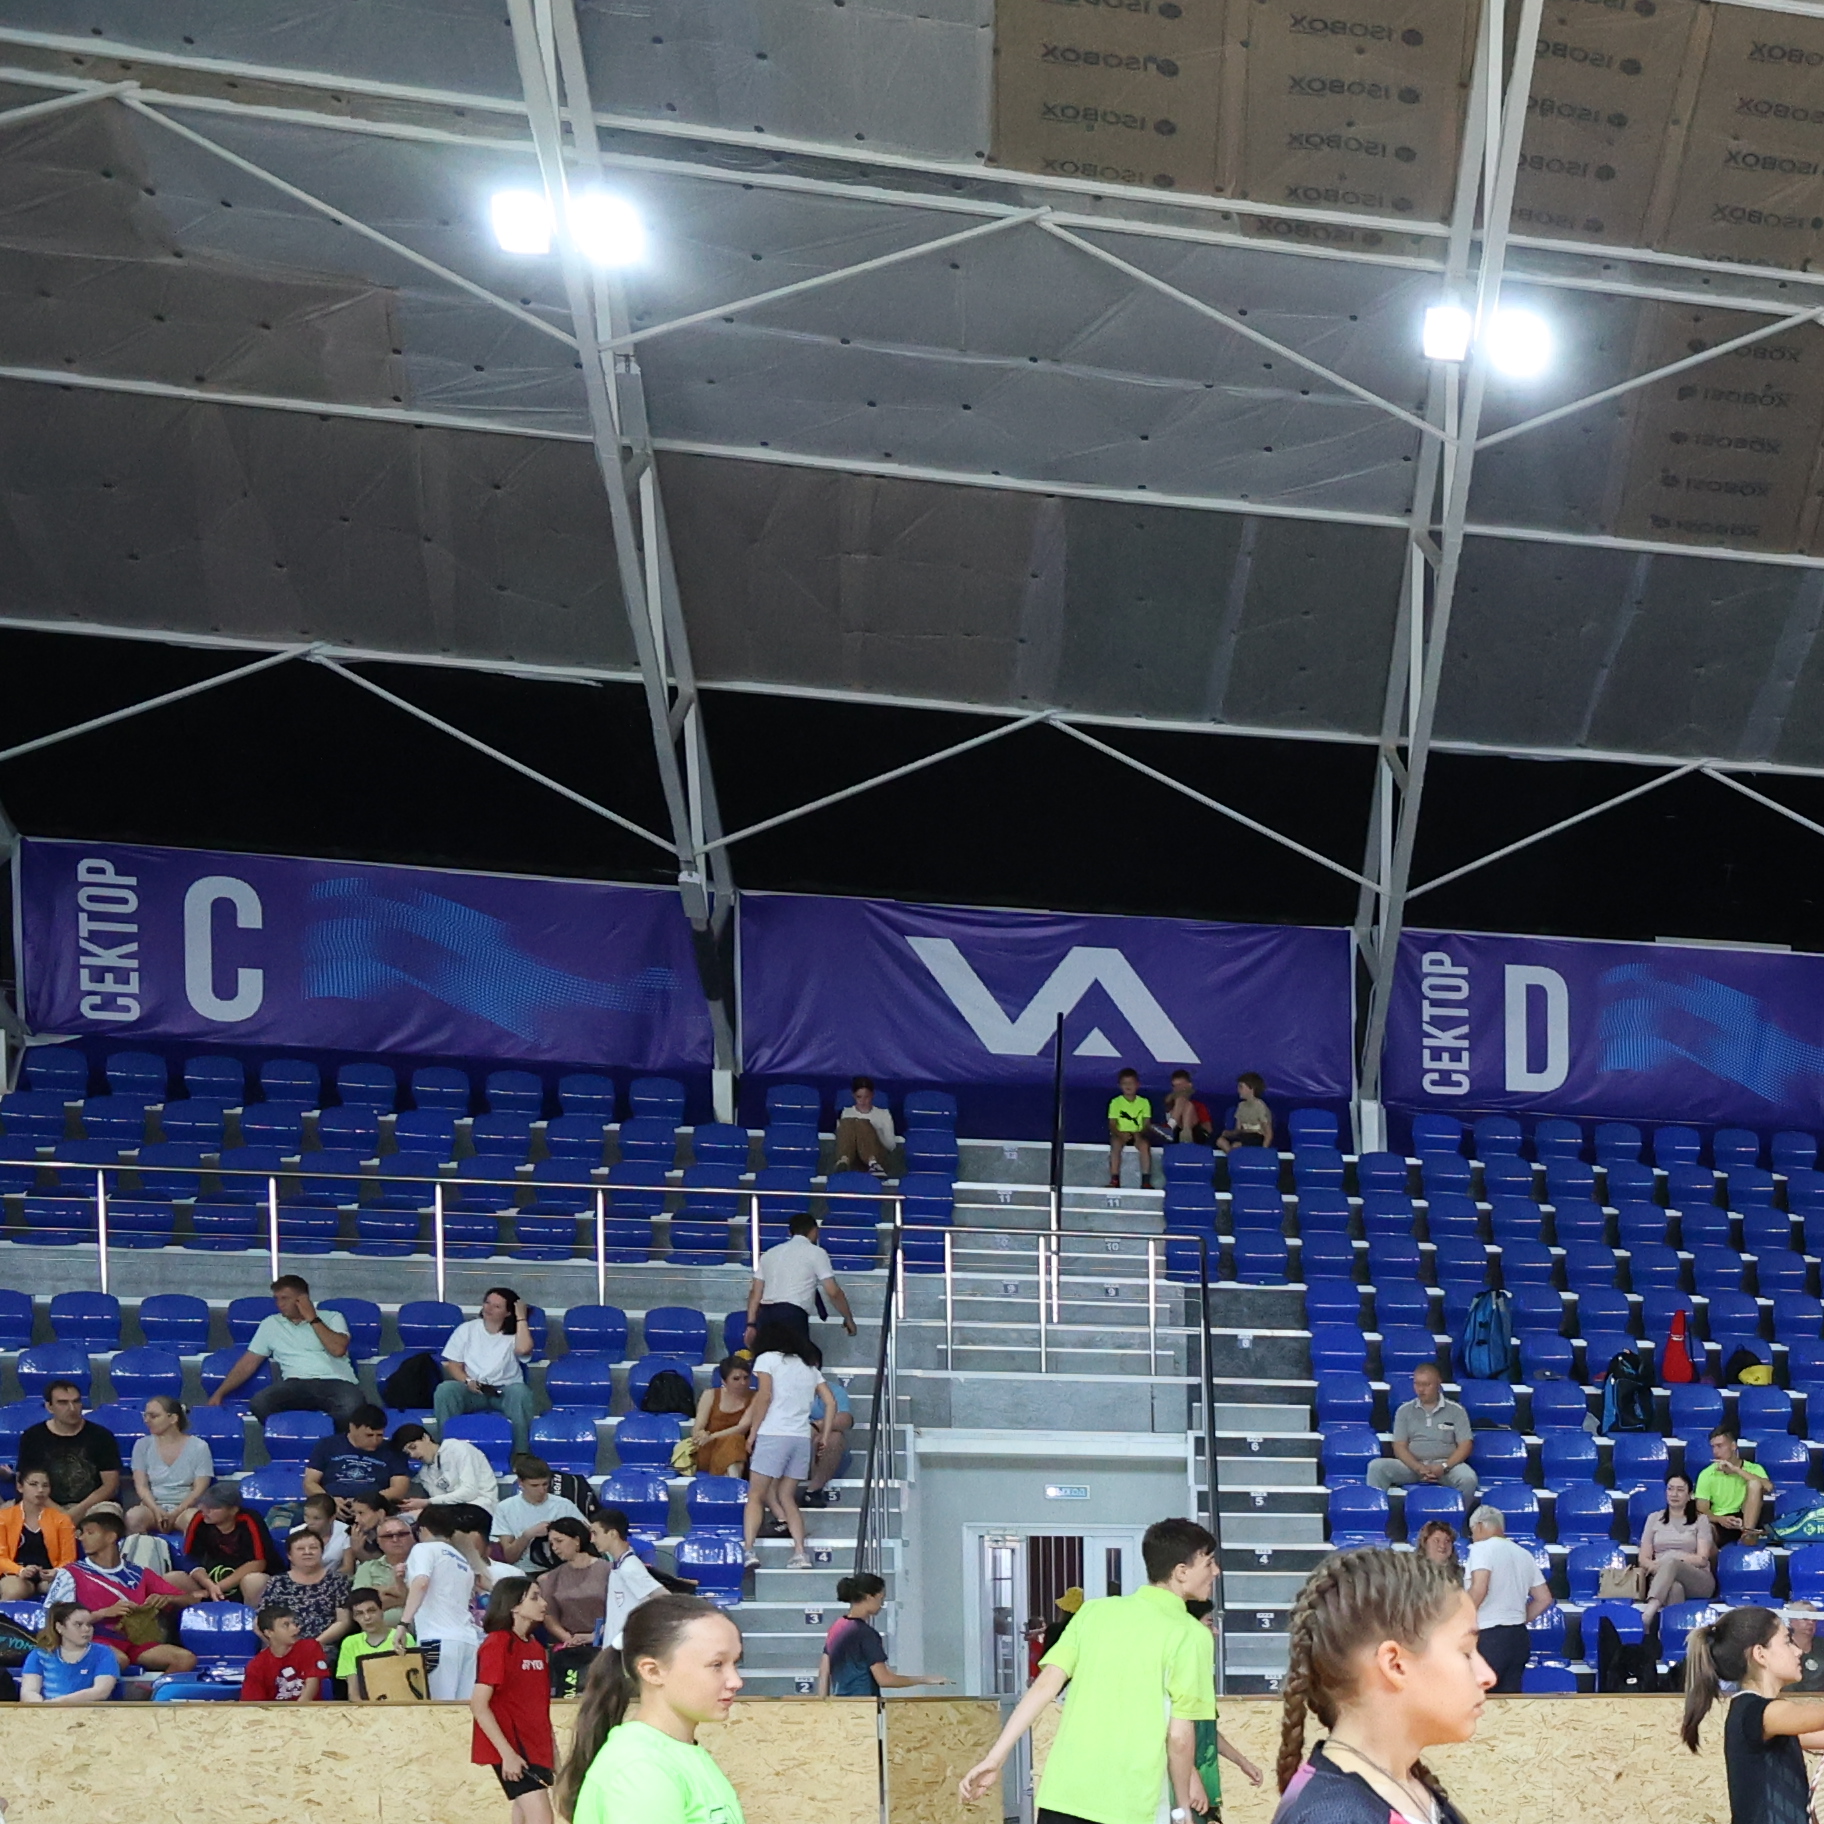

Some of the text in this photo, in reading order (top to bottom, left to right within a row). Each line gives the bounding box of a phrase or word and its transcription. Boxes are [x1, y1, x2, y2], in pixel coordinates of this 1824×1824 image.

[76, 858, 138, 1022] СЕКТОР
[183, 875, 264, 1023] C
[1422, 951, 1470, 1096] СЕКТОР
[1504, 964, 1569, 1092] D
[1047, 1487, 1086, 1498] ЫХОД
